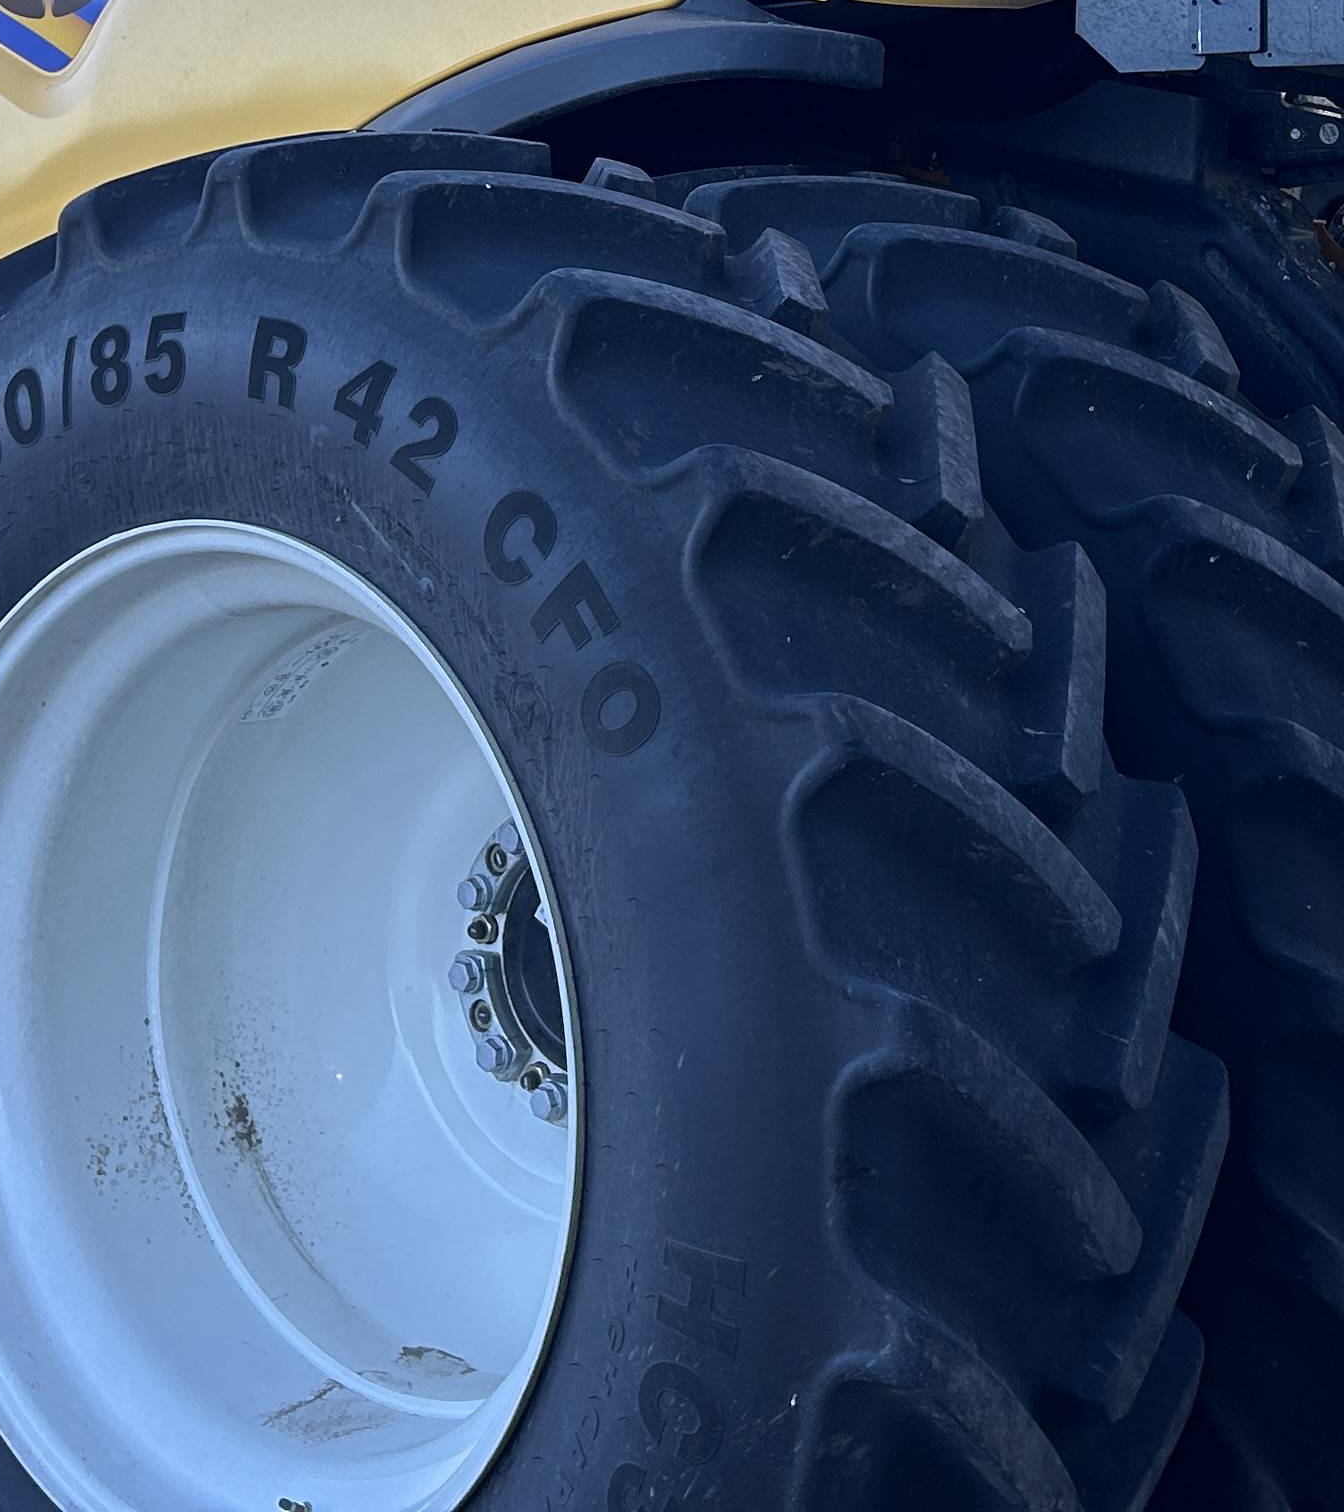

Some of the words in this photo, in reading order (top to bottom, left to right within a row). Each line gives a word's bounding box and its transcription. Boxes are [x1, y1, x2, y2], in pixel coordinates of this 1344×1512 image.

[247, 316, 308, 412] R
[333, 359, 458, 497] 42
[483, 490, 661, 757] CFO
